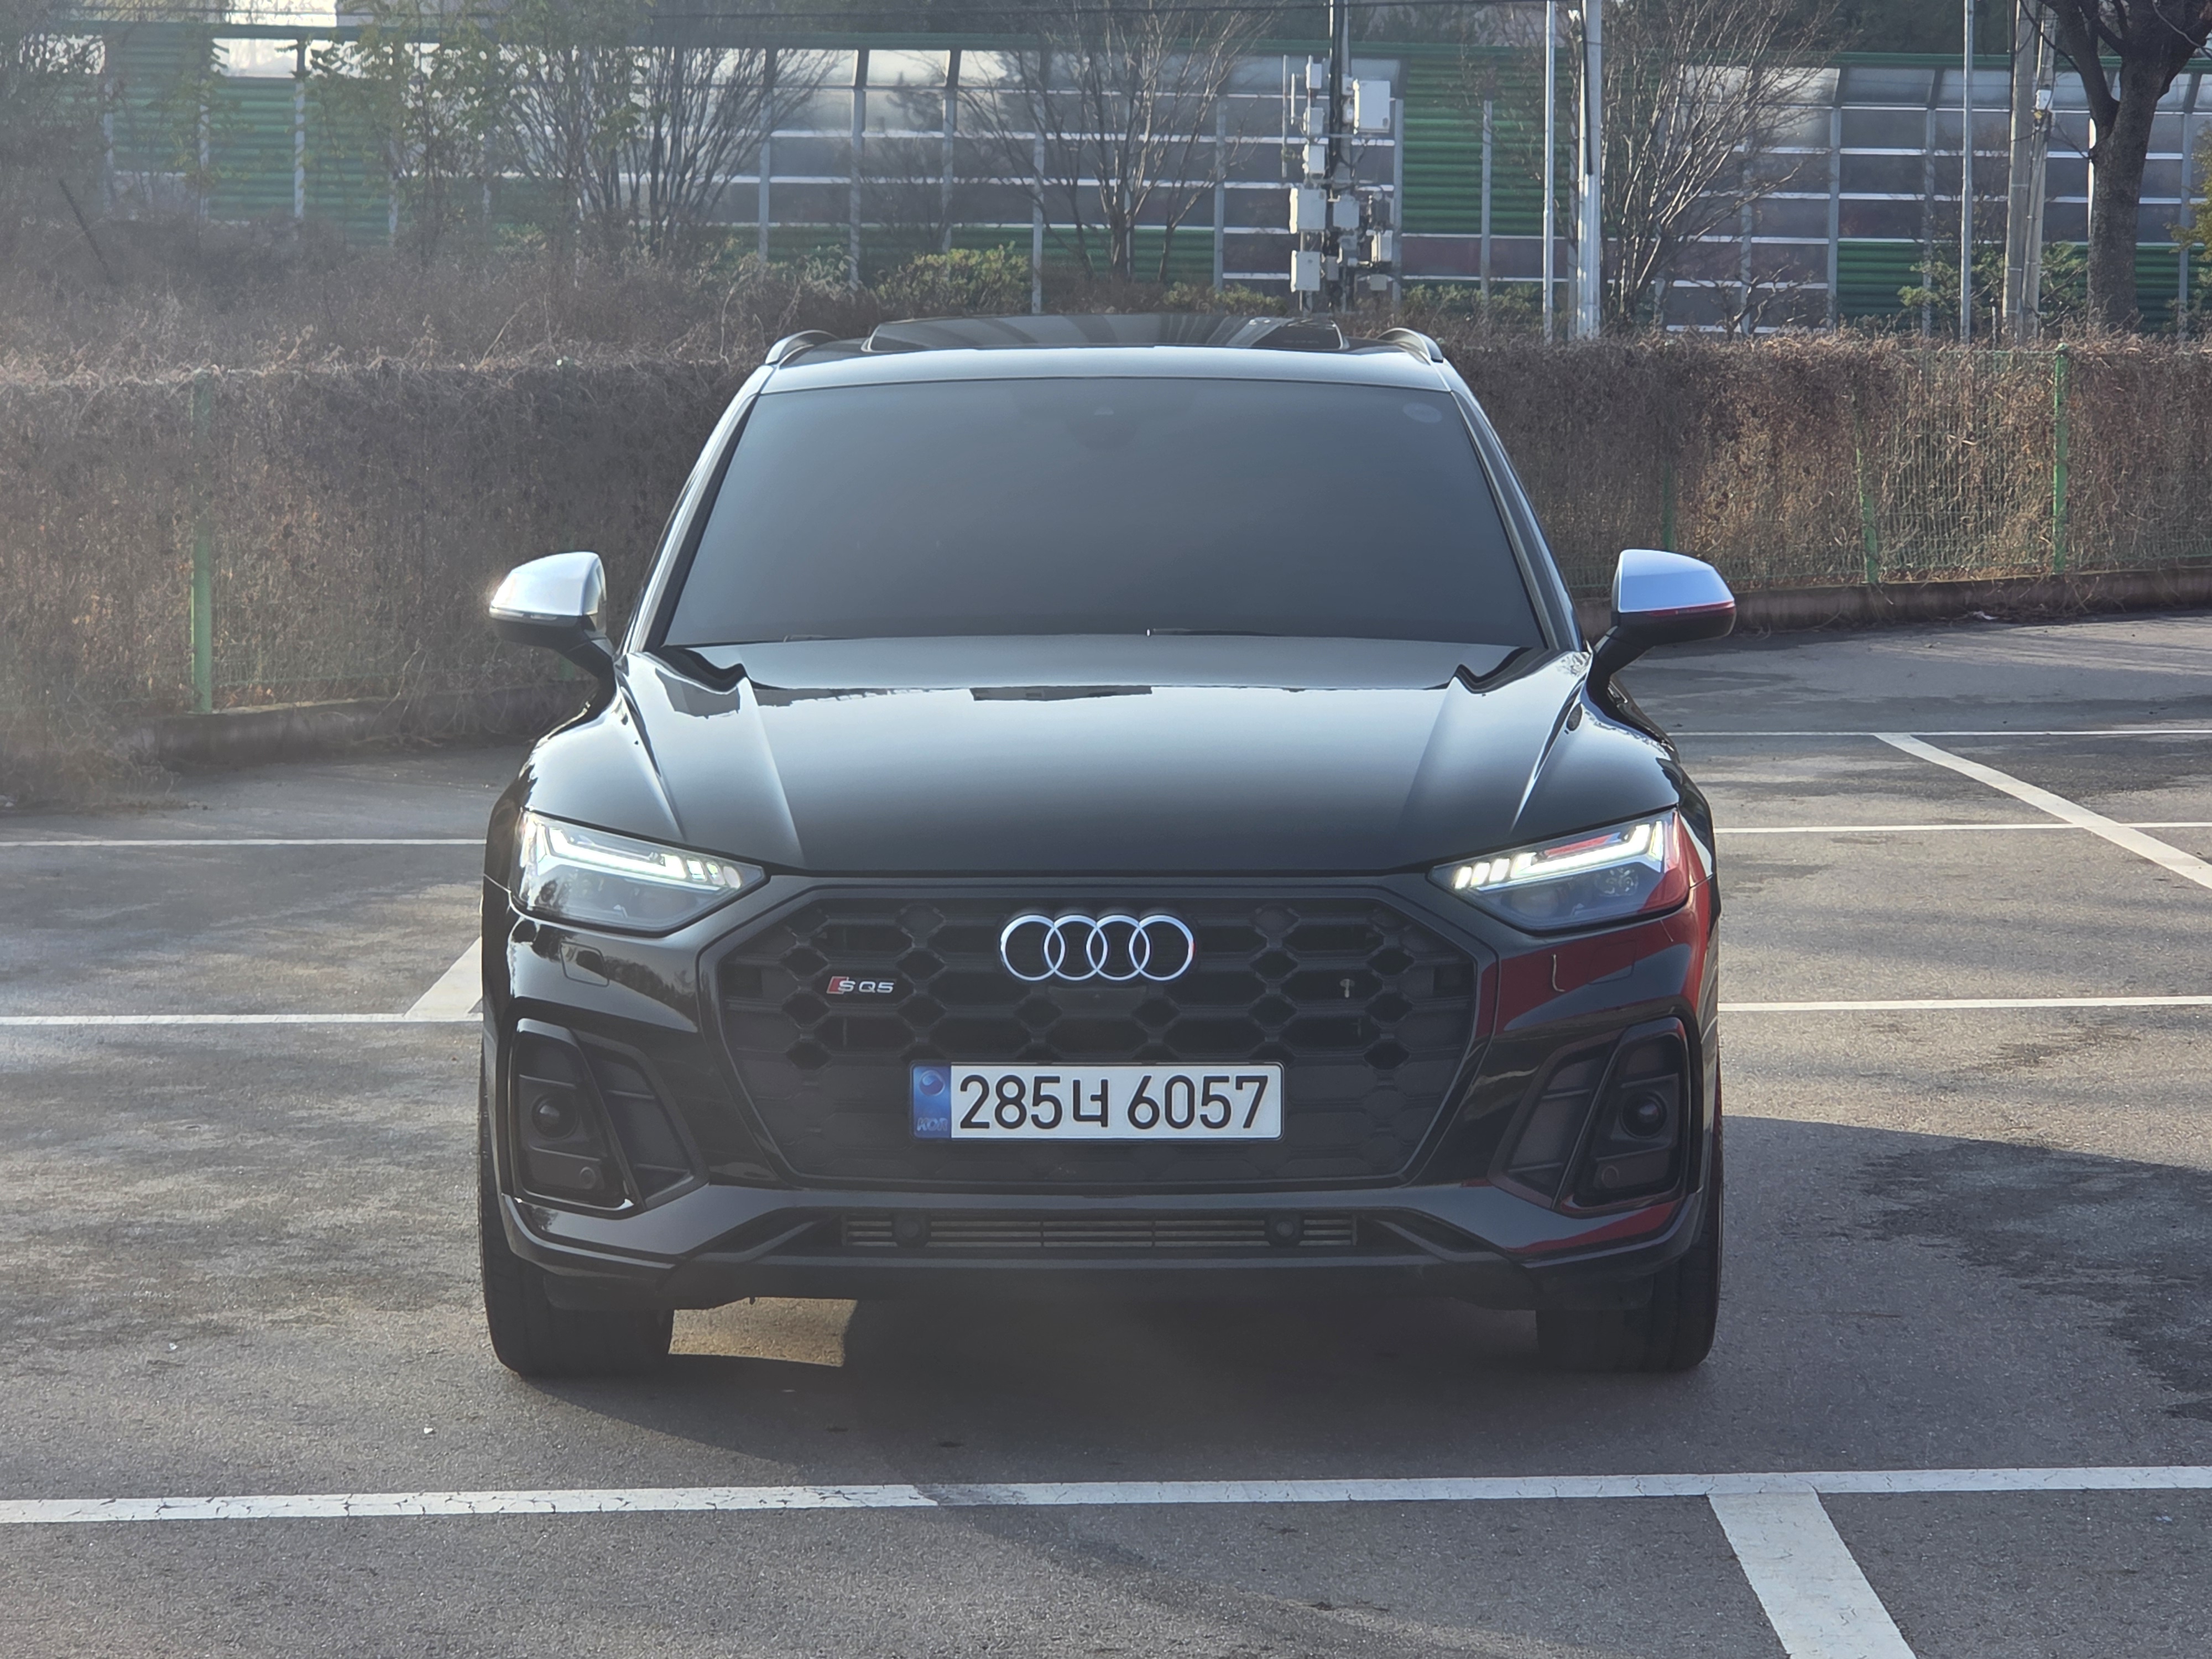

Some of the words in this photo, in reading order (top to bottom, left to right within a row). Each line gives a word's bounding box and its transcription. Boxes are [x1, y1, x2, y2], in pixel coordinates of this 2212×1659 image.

[838, 981, 895, 993] SQ5
[960, 1075, 1108, 1129] 285너
[1127, 1075, 1268, 1129] 6057
[916, 1117, 948, 1131] KOR
